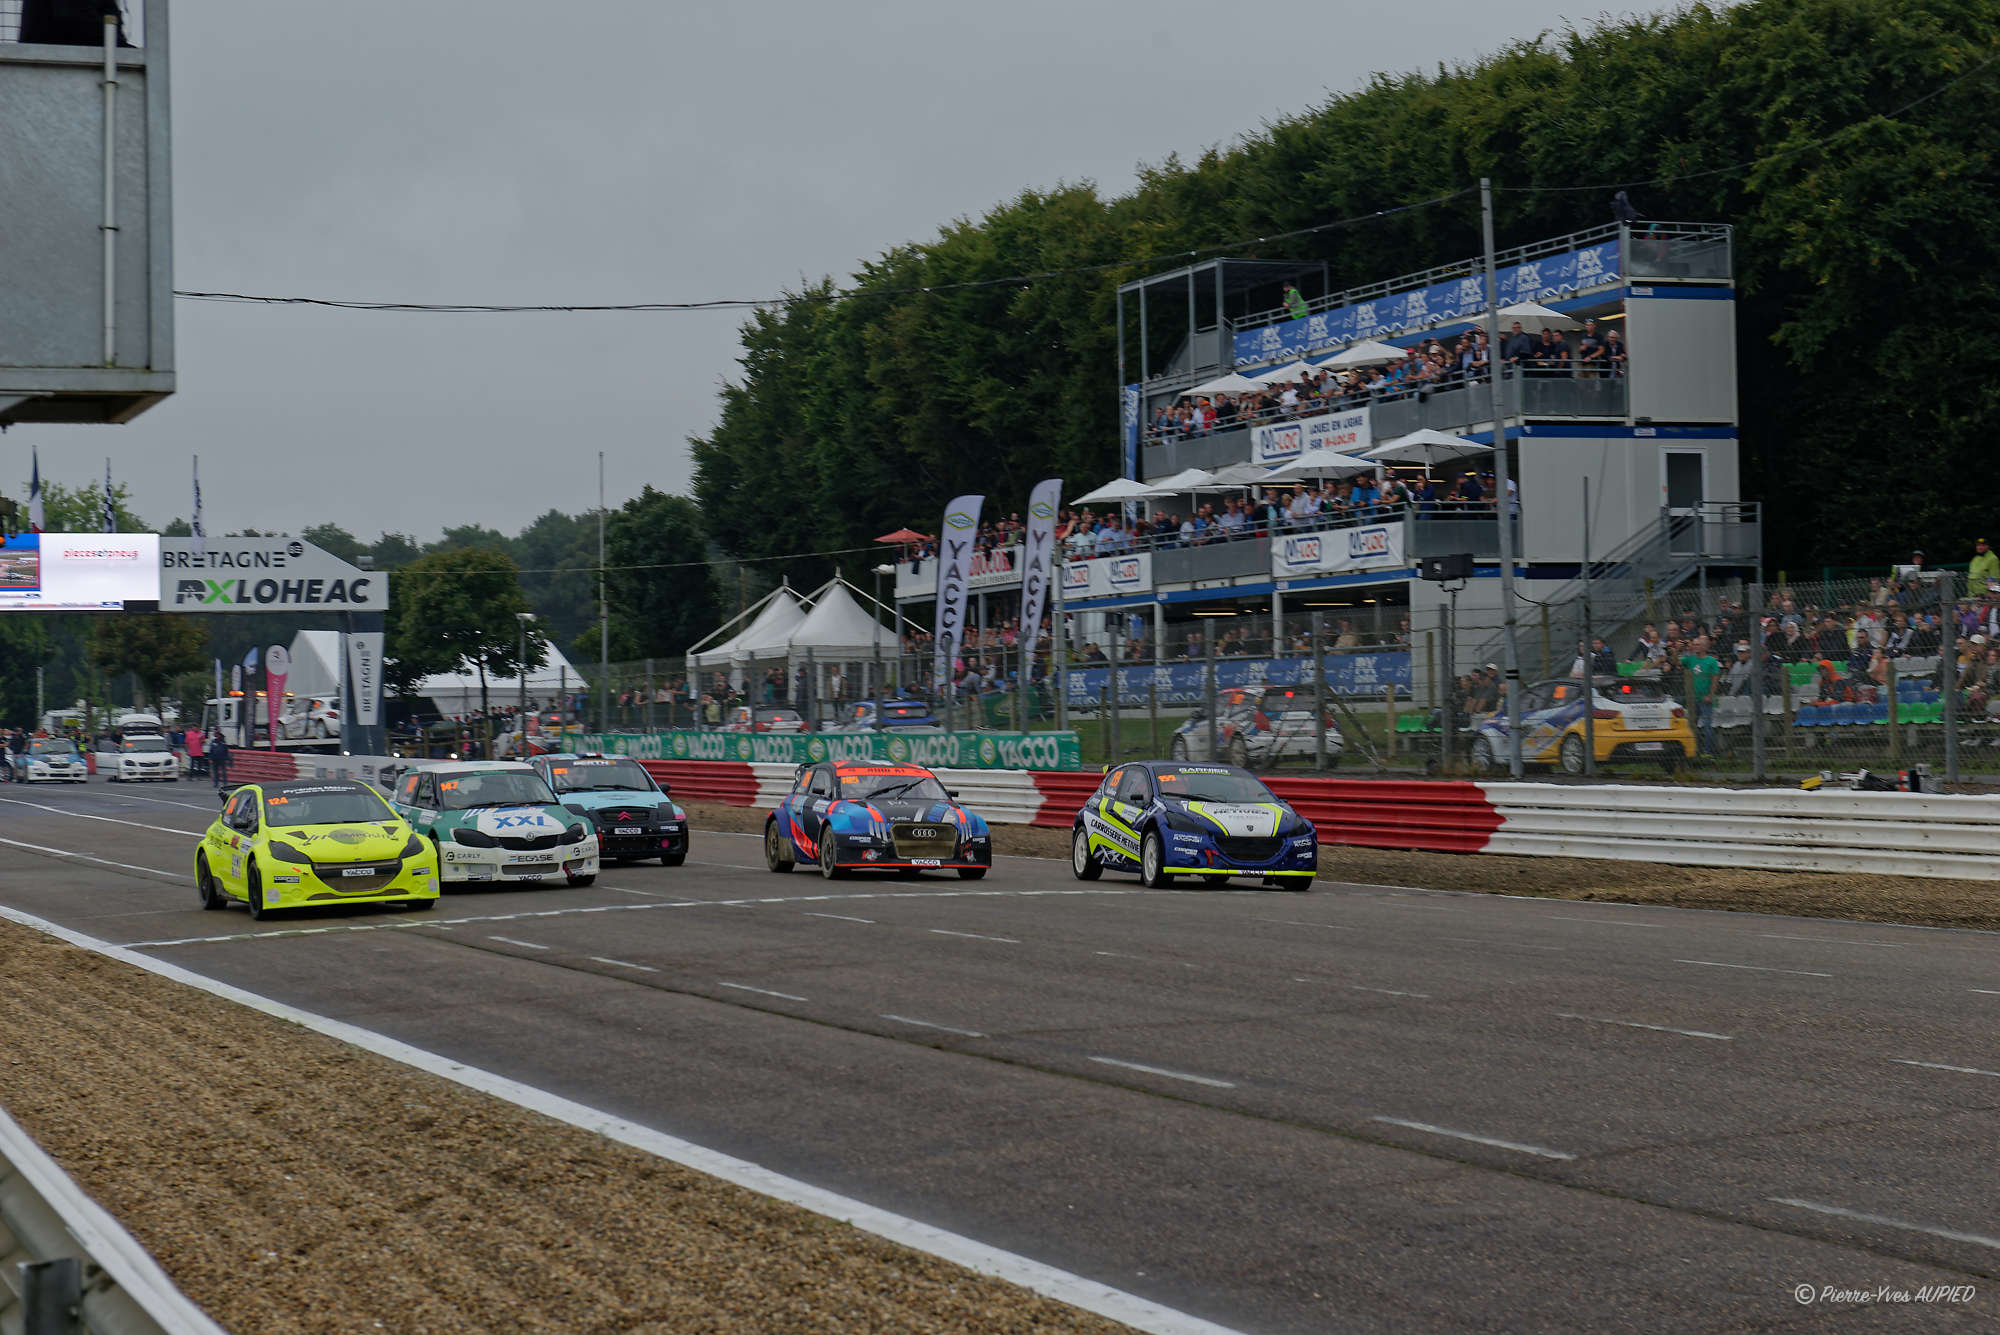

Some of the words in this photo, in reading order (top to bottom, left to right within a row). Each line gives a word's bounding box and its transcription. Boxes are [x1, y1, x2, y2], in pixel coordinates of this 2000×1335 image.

[163, 551, 286, 568] BRETAGNE
[235, 578, 371, 604] LOHEAC
[361, 651, 372, 712] BRETAGNE
[687, 734, 725, 759] YACCO
[752, 738, 792, 763] YACCO
[826, 735, 872, 762] YACCO
[908, 735, 959, 766] YACCO
[999, 736, 1059, 768] YACCO
[494, 815, 552, 829] XXL
